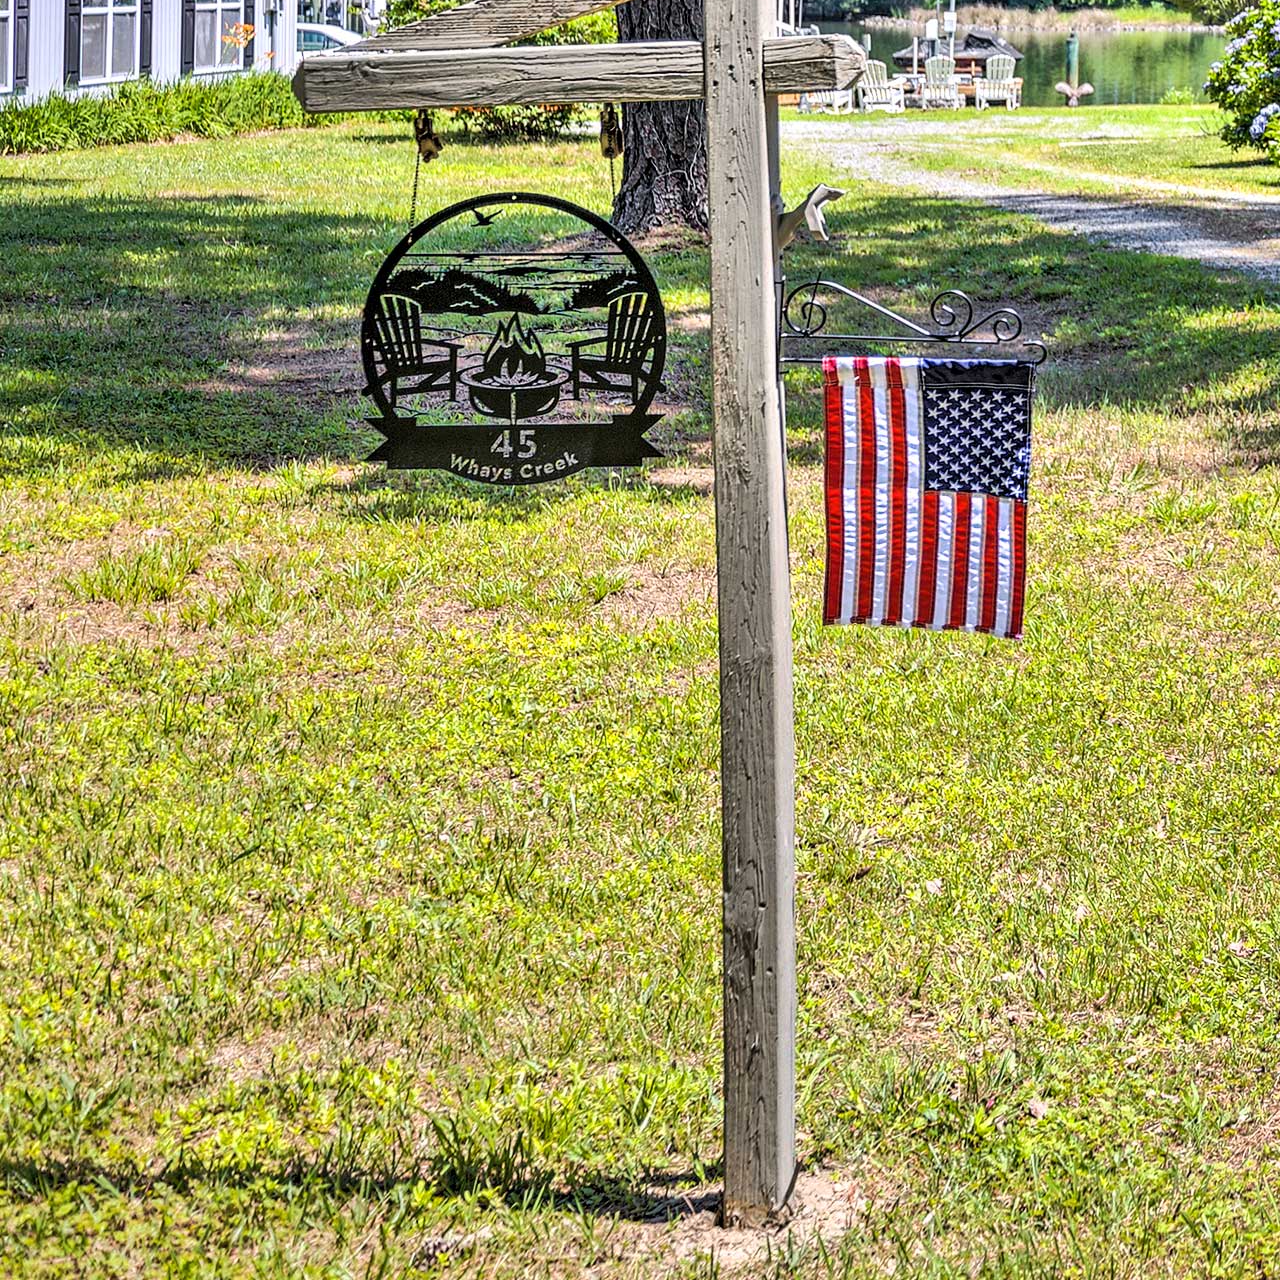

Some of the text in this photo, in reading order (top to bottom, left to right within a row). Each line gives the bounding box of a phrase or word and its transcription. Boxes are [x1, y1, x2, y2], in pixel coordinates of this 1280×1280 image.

[490, 429, 538, 458] 45
[450, 451, 579, 482] Whays Creek
